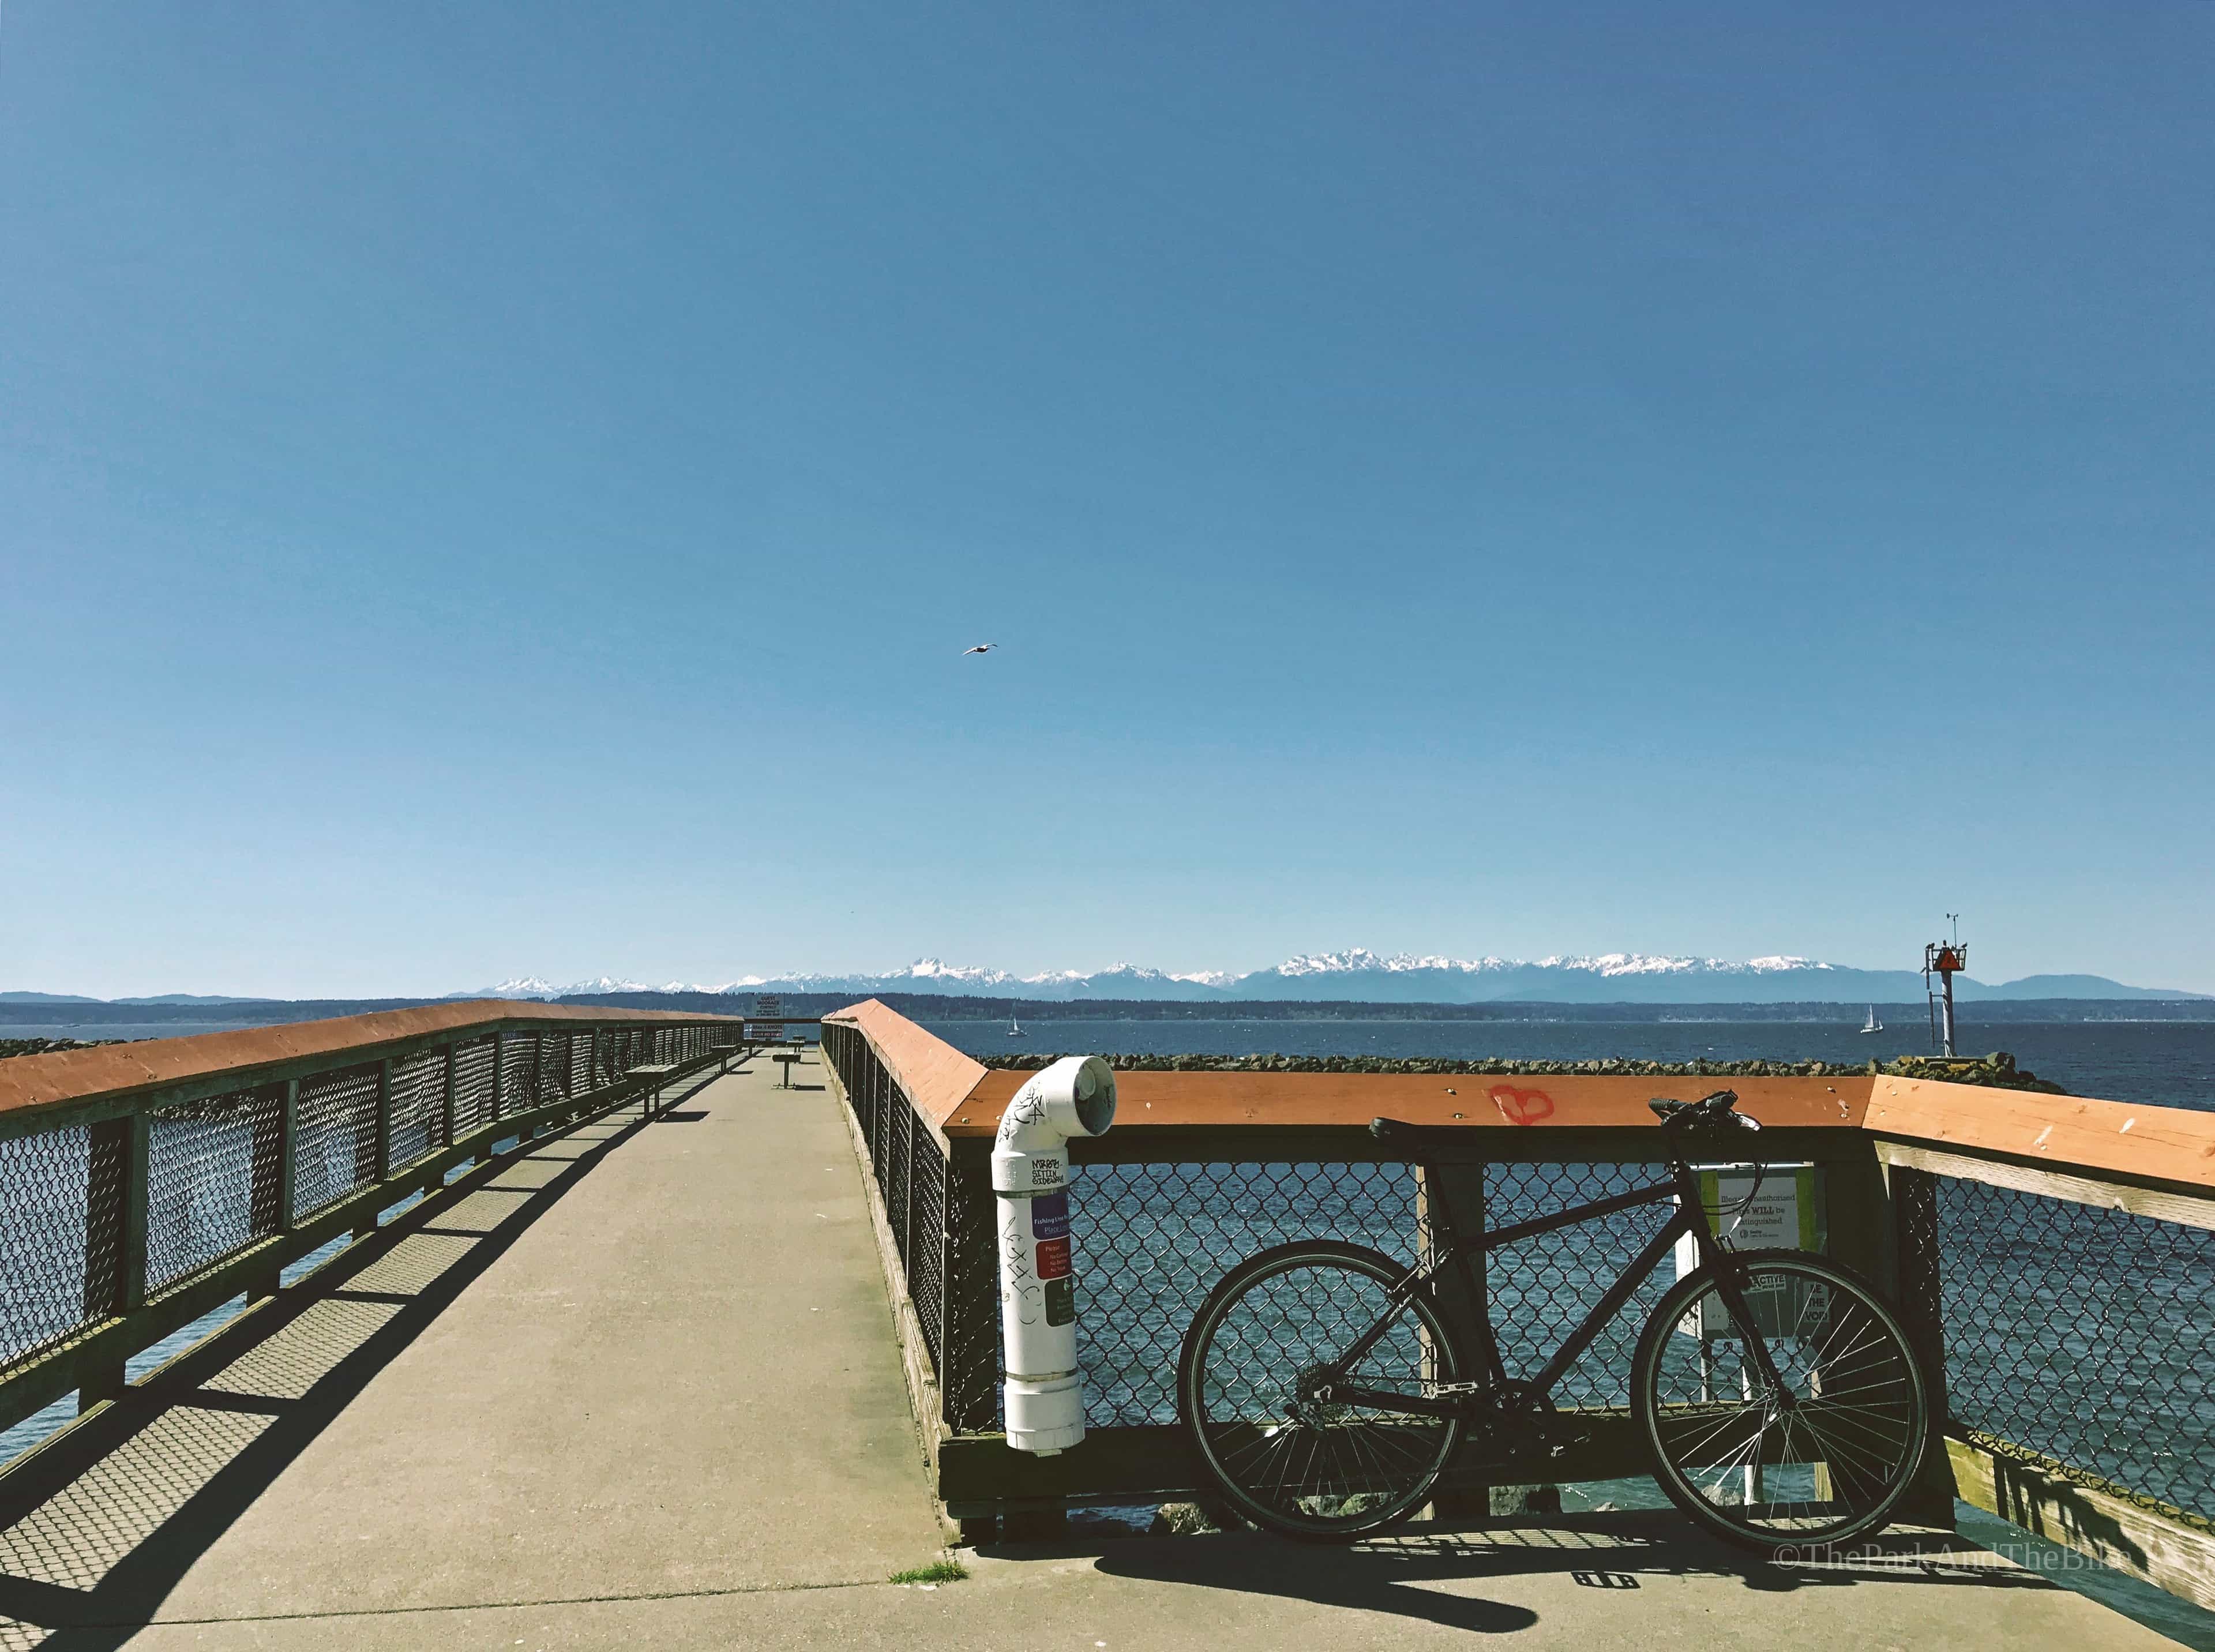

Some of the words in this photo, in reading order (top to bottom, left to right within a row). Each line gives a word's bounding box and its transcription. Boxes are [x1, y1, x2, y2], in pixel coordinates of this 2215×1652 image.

[1751, 1207, 1774, 1215] WILL
[1776, 1206, 1785, 1214] be
[1808, 1298, 1825, 1307] THE
[1804, 1311, 1828, 1321] VOID
